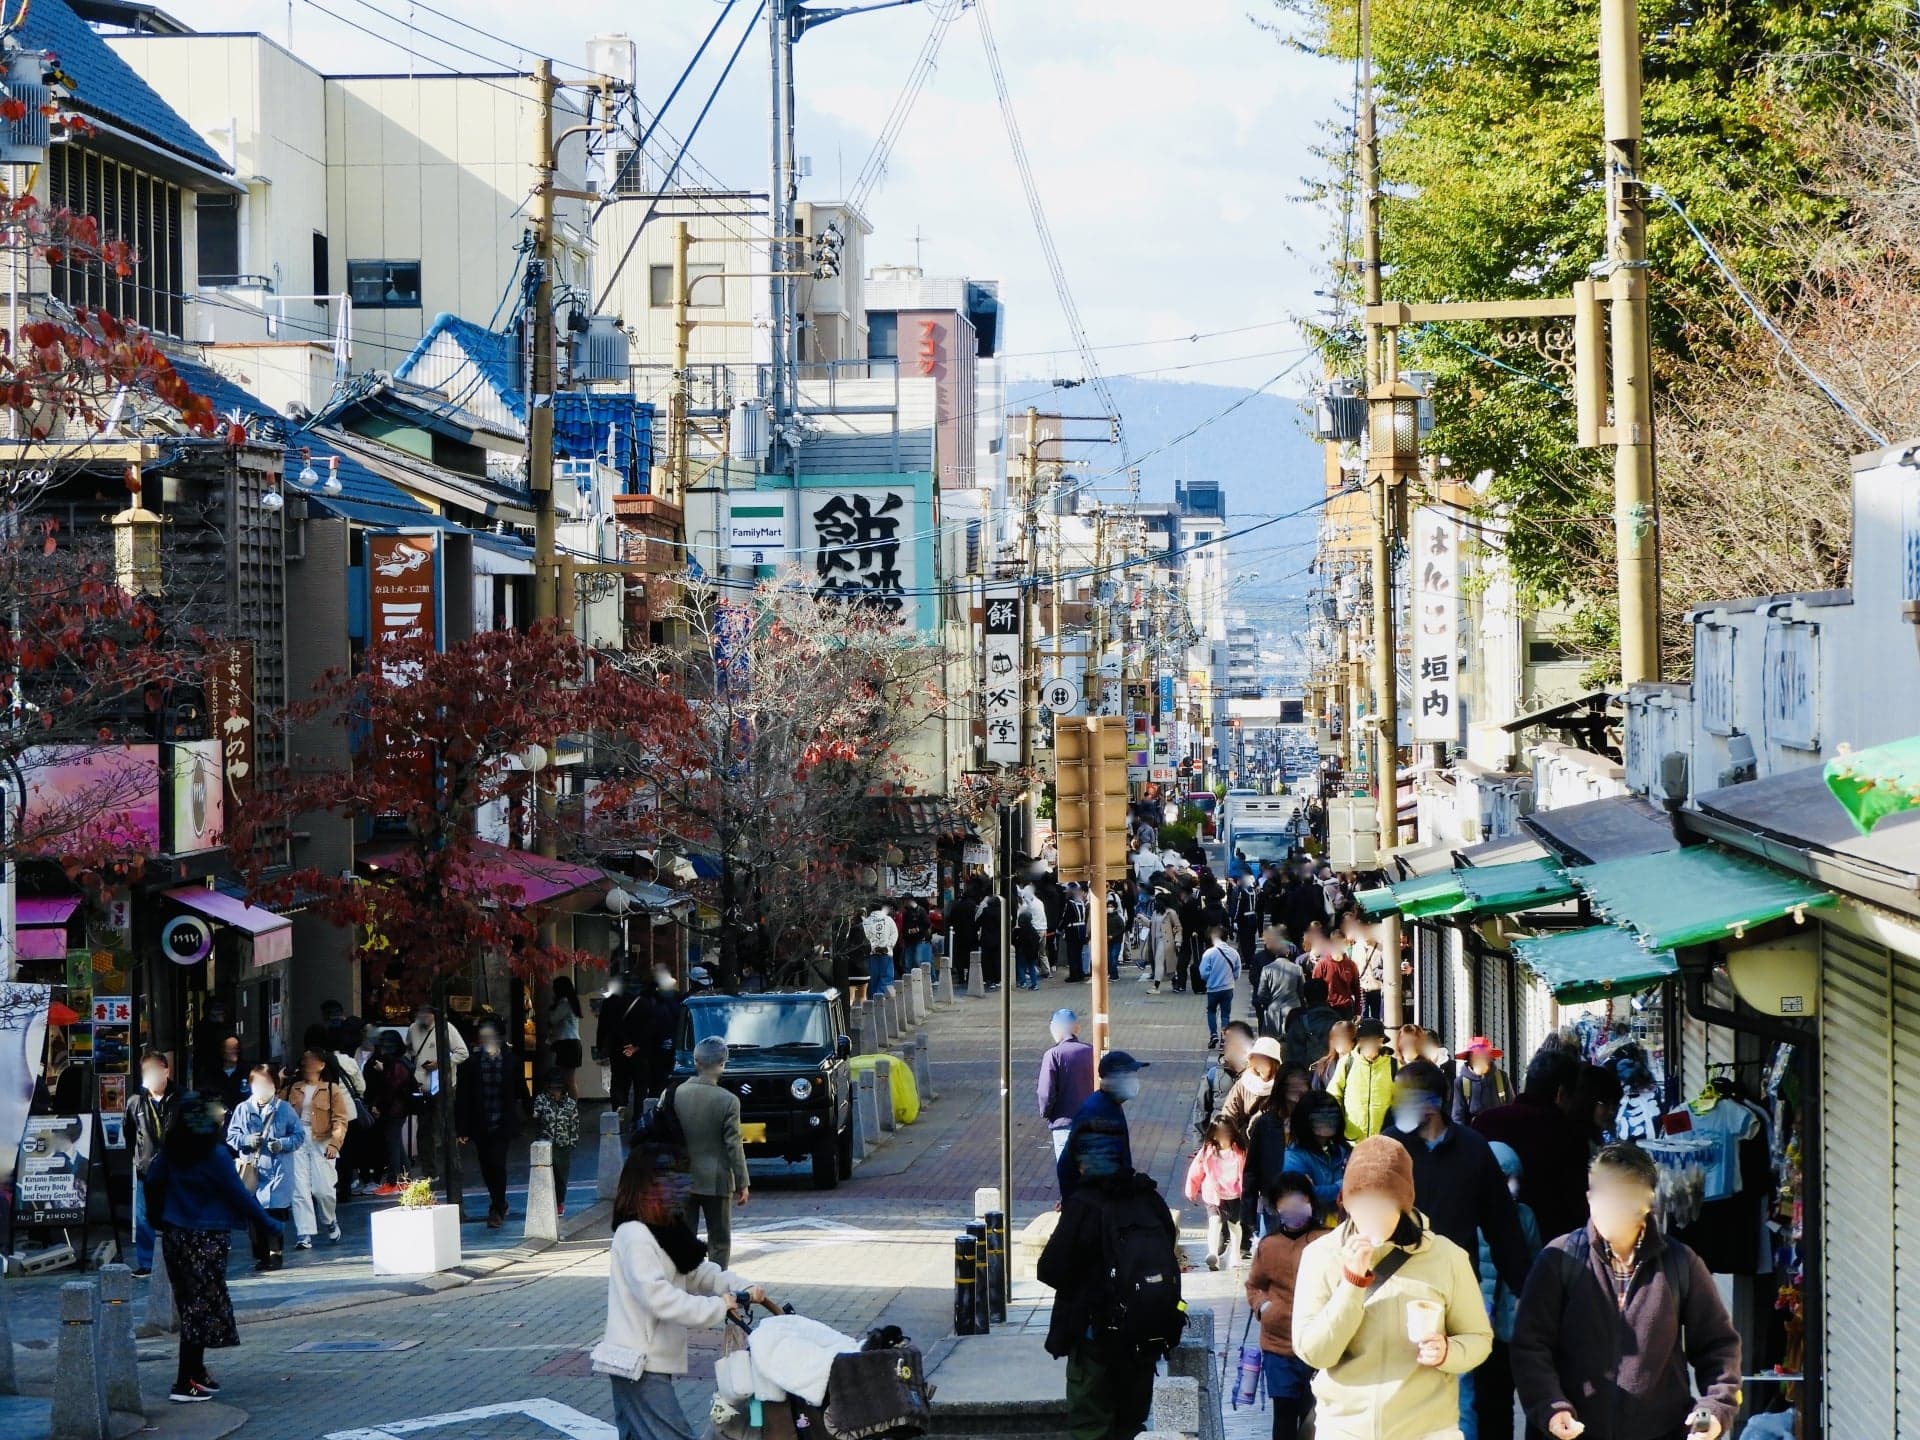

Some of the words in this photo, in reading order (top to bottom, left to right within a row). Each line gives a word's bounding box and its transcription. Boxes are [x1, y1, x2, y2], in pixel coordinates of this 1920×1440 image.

[732, 527, 782, 539] FamilyMart
[752, 551, 764, 564] 酒
[987, 601, 1017, 632] 餅
[1421, 654, 1450, 717] 垣内
[987, 650, 1018, 746] 中谷堂
[25, 1175, 48, 1183] Kimono
[49, 1175, 71, 1183] Rentals
[34, 1184, 51, 1192] Every
[52, 1184, 67, 1192] Body
[36, 1192, 52, 1200] Every
